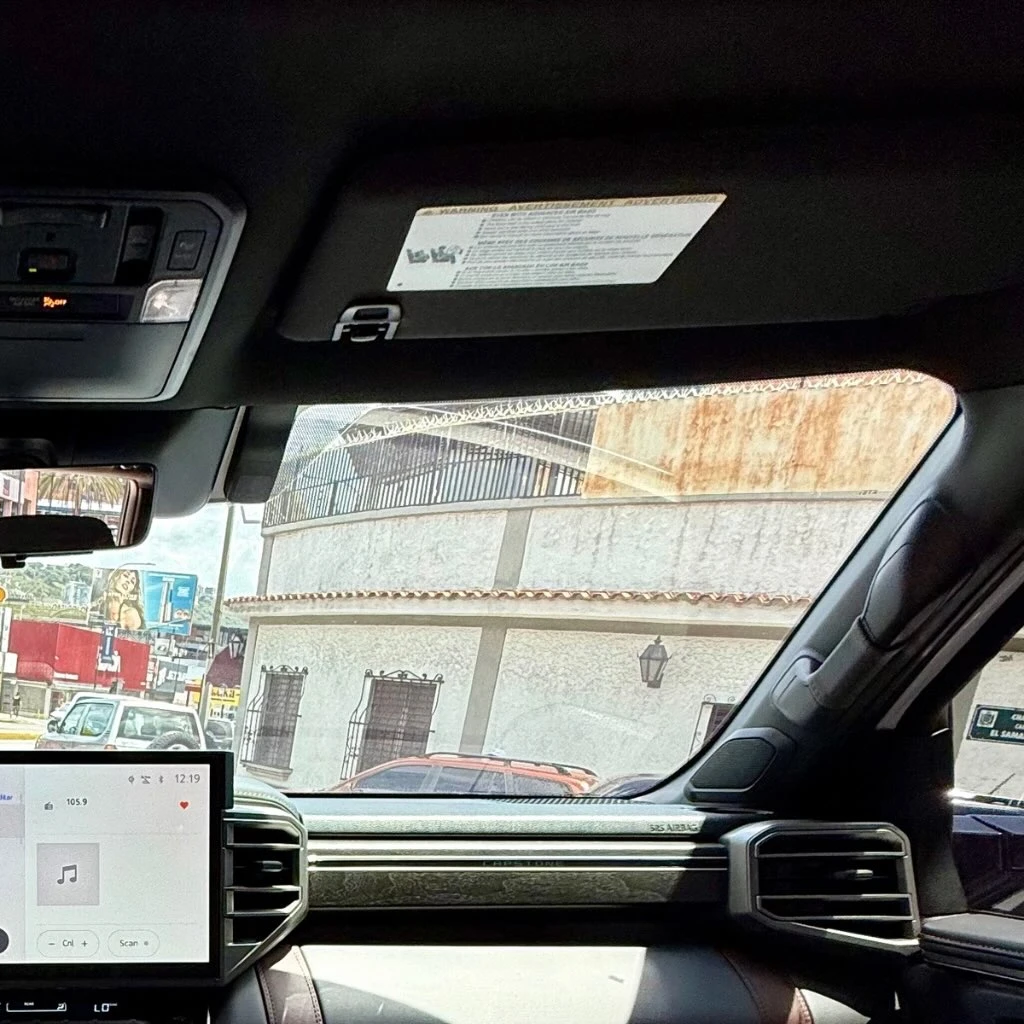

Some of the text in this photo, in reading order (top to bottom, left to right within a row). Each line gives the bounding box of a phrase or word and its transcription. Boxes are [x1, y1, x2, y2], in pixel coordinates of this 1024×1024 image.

[990, 729, 1024, 740] EL SAMA
[66, 798, 88, 806] 105.9
[119, 939, 138, 947] Scan
[93, 1003, 110, 1013] LO
